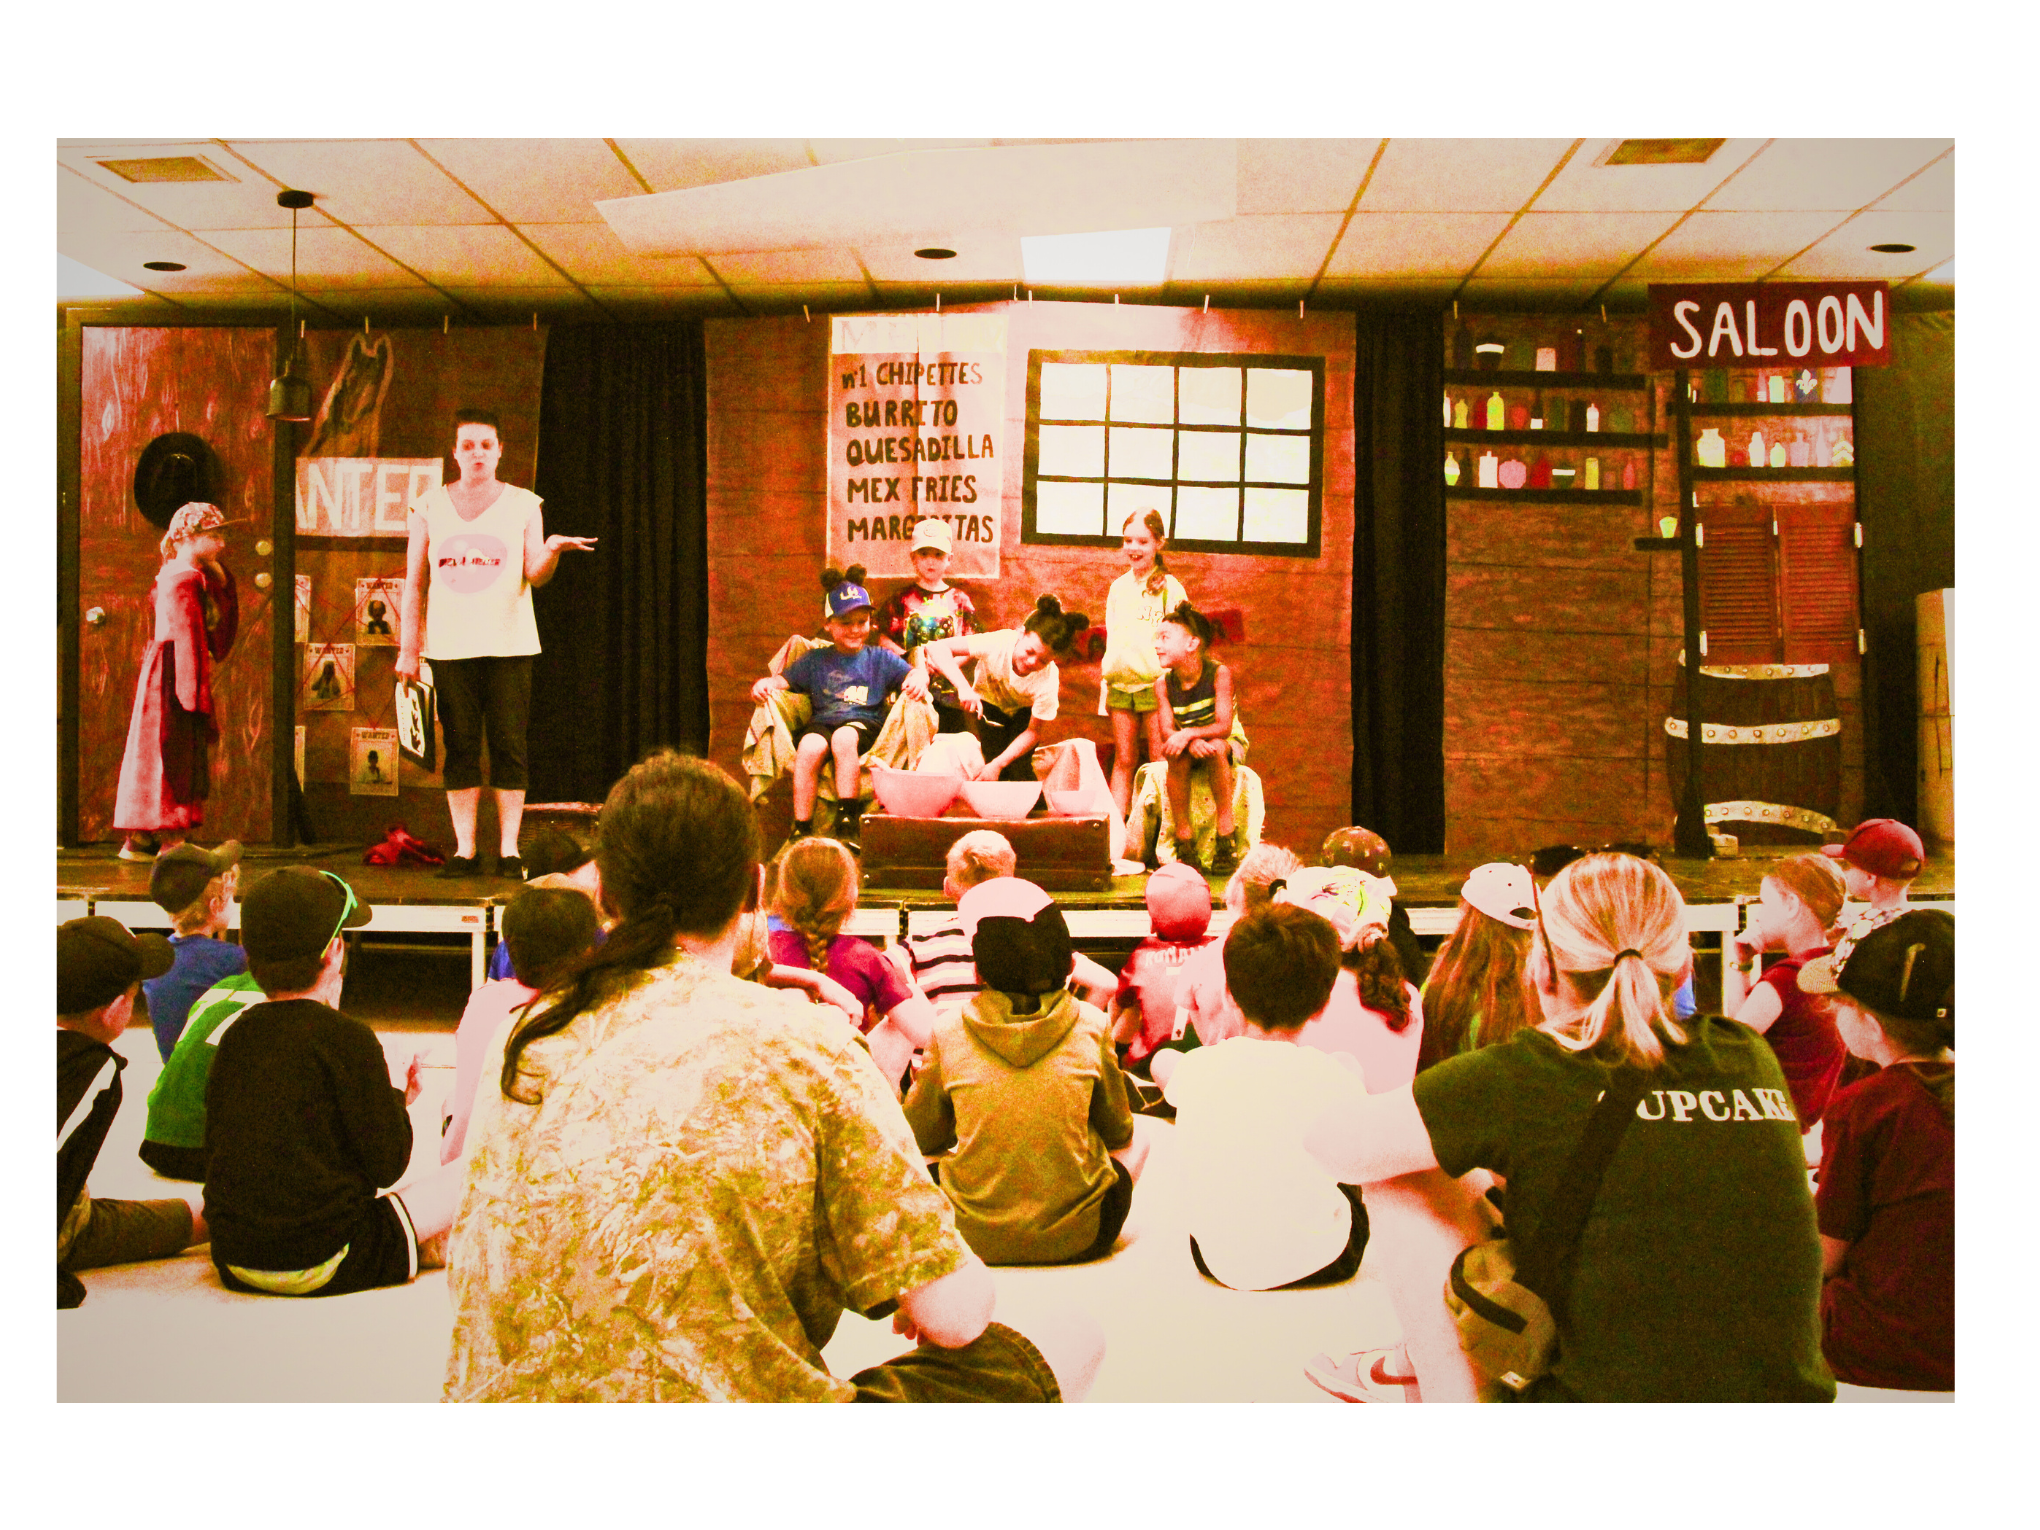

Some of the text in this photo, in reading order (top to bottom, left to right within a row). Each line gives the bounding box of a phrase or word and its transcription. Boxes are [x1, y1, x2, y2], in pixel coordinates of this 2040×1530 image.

[841, 319, 1001, 351] MEN
[1670, 290, 1884, 358] SALOON
[876, 362, 983, 385] CHIPETTES
[846, 399, 958, 427] BURRITO
[846, 434, 994, 466] QUESADILLA
[847, 475, 978, 503] MEX FRIES
[847, 514, 994, 543] MARGTAS
[1597, 1087, 1797, 1121] UPCAKE
